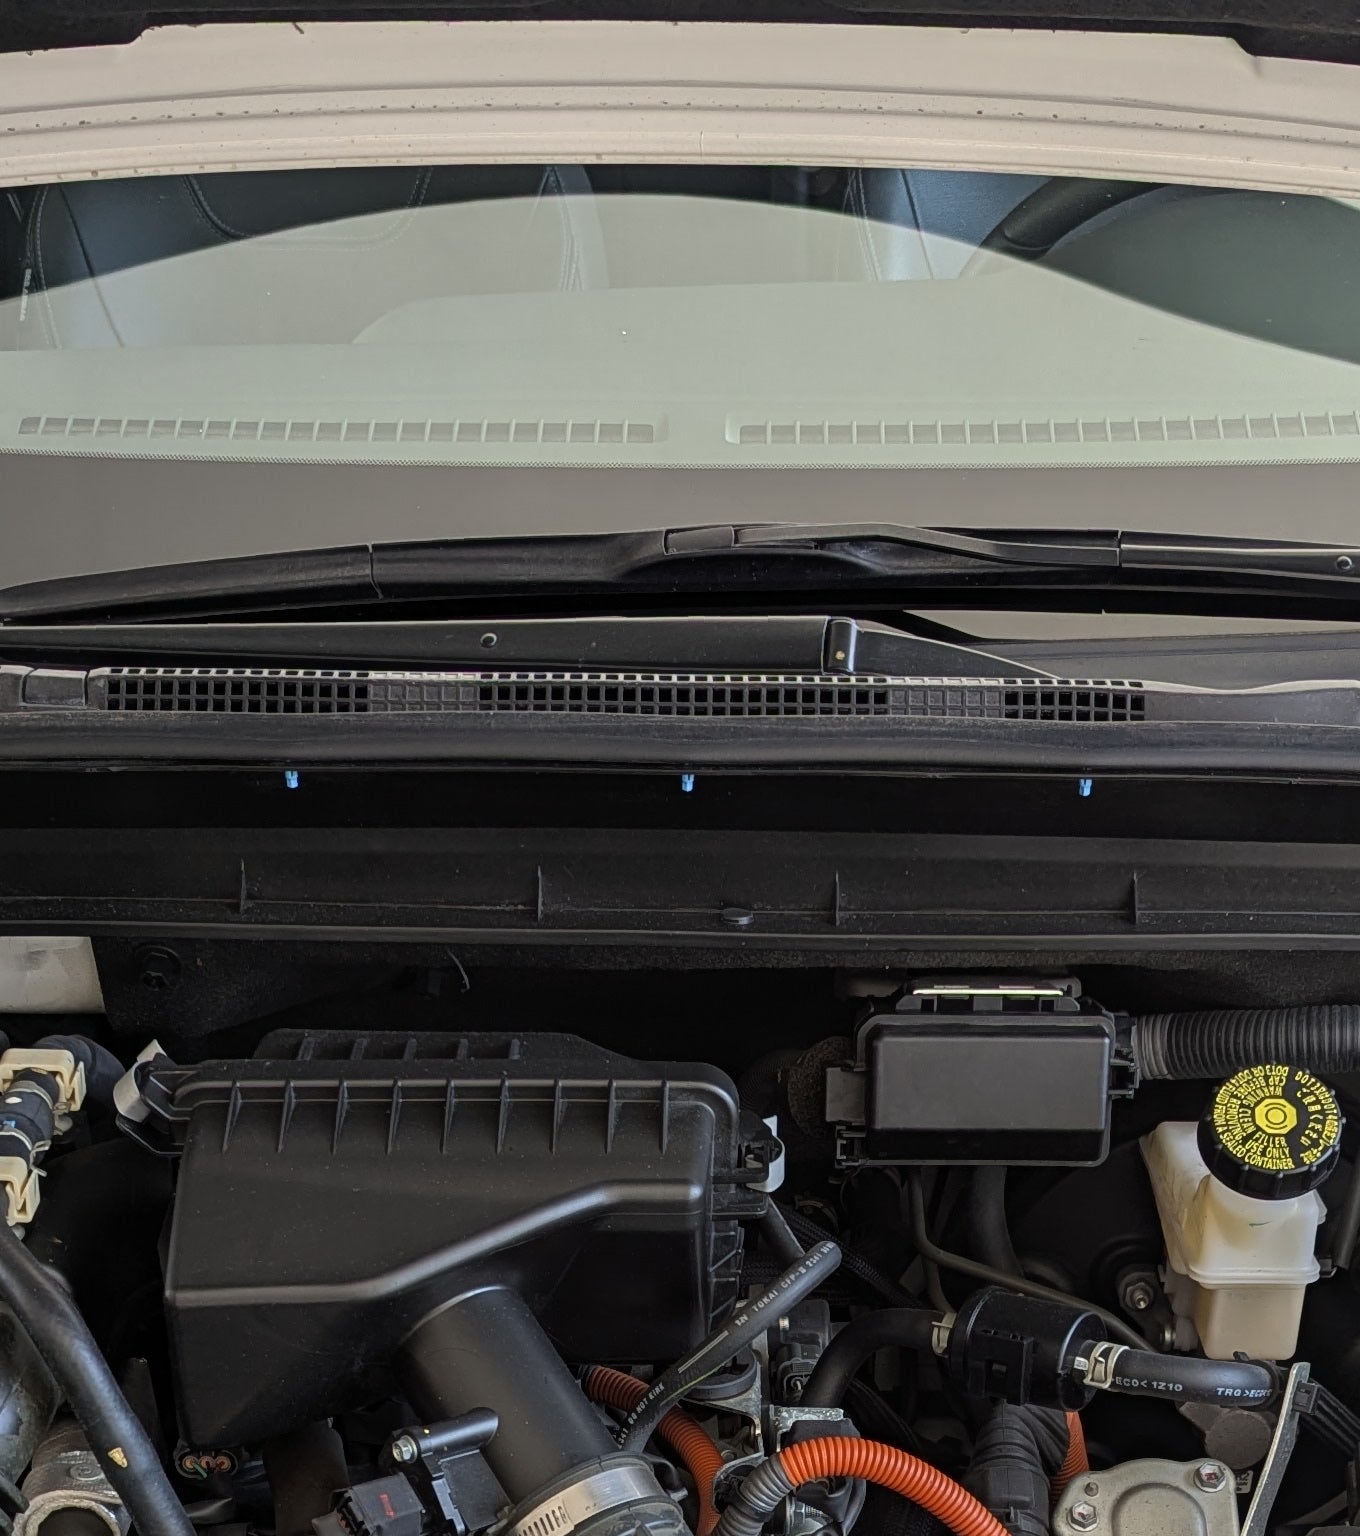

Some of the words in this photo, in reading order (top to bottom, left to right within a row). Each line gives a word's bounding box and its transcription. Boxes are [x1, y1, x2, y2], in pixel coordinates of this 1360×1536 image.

[1265, 1065, 1289, 1077] DOT3
[1268, 1075, 1286, 1087] CAP
[1242, 1086, 1283, 1108] WARNING
[1213, 1104, 1226, 1126] FROM
[1238, 1108, 1257, 1134] CLEAN
[1215, 1126, 1228, 1134] A
[1219, 1132, 1247, 1158] SEALED
[1245, 1139, 1264, 1155] USE
[1252, 1131, 1287, 1148] FILLER
[1244, 1152, 1296, 1170] CONTAINER
[1266, 1147, 1290, 1158] ONLY
[752, 1289, 779, 1312] TOKAI
